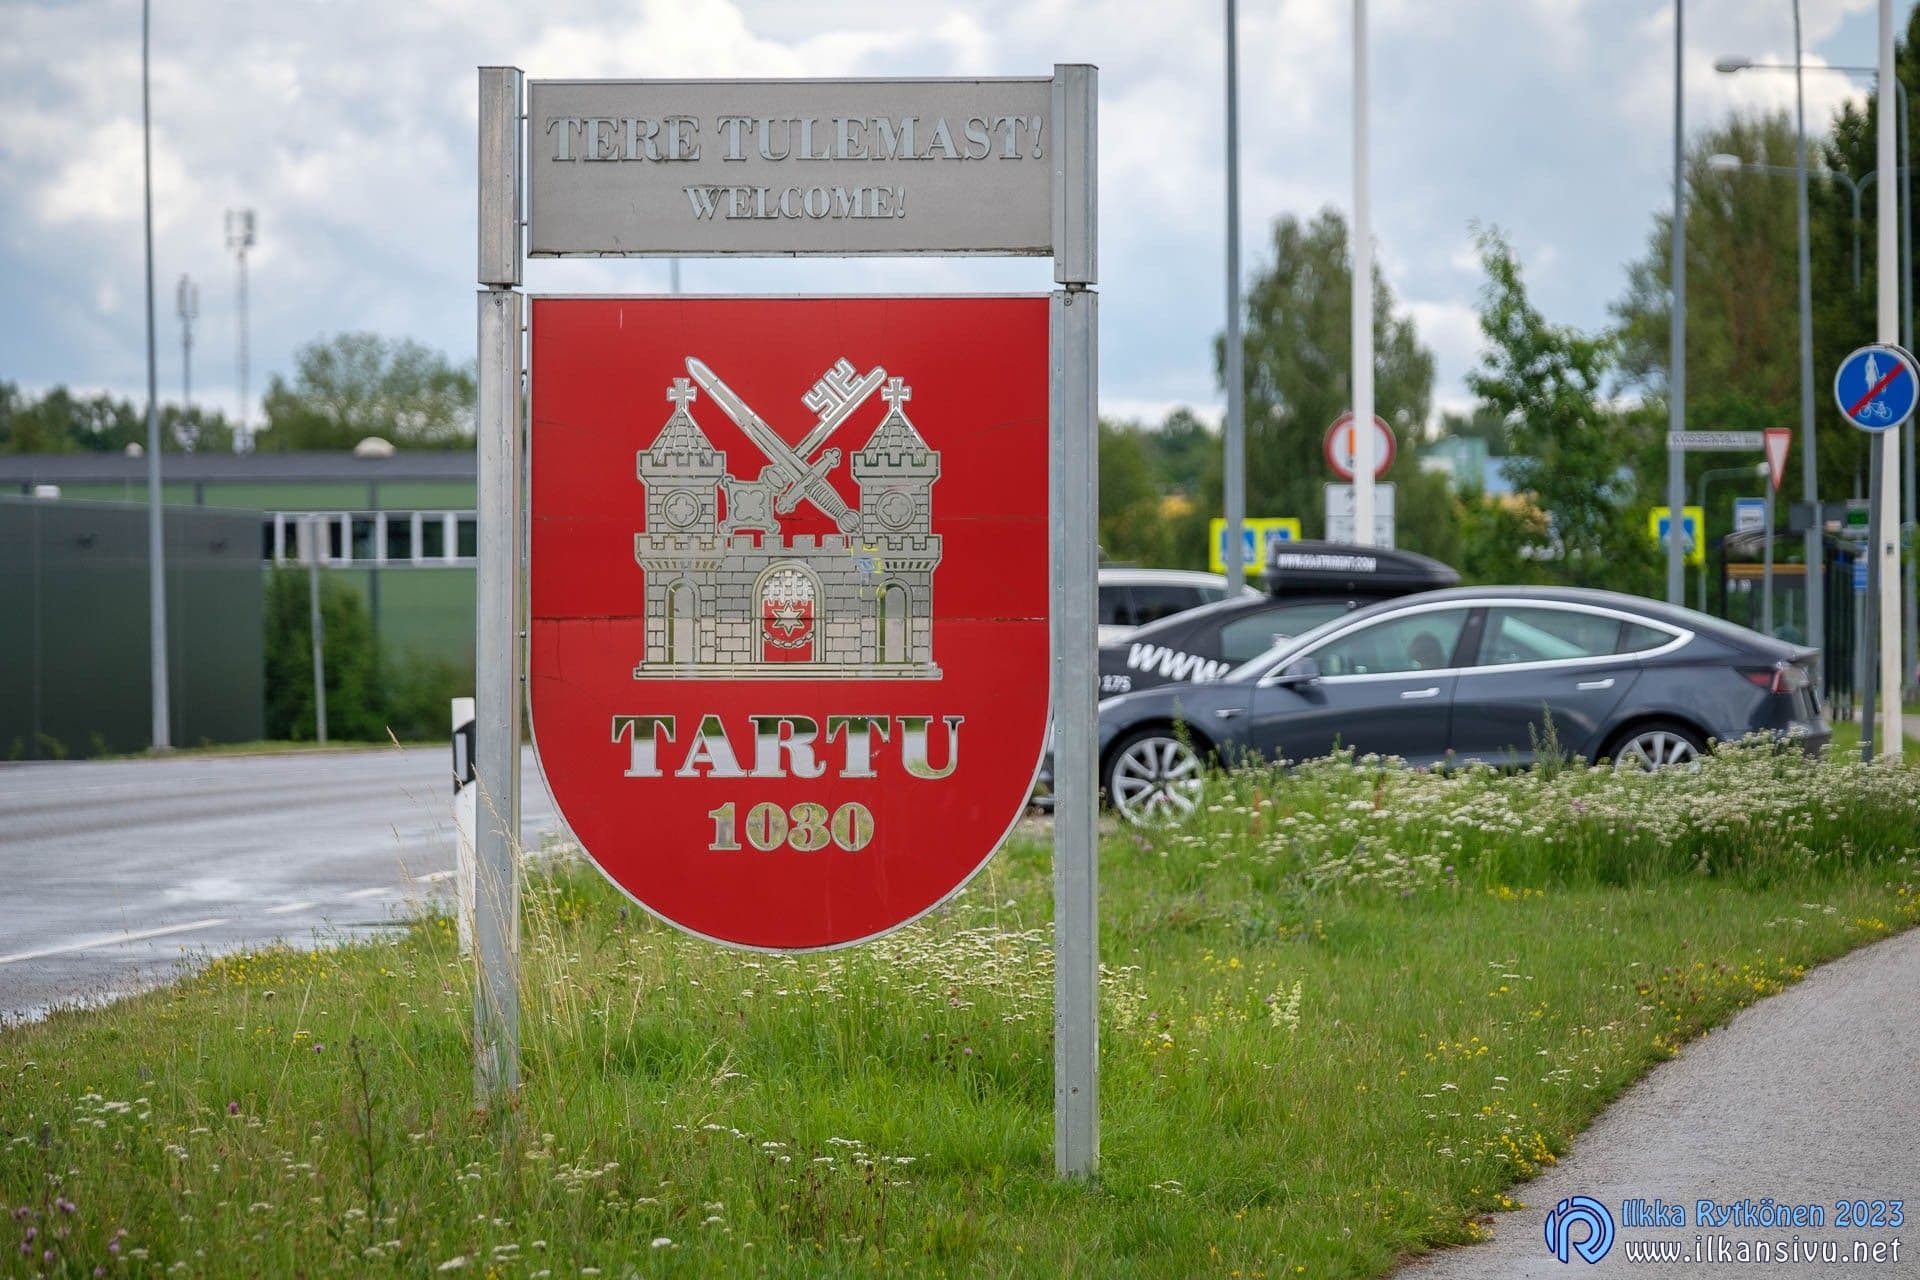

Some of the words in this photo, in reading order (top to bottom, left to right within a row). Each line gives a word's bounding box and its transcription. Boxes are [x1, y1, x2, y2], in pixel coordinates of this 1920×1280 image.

[546, 115, 701, 162] TERE
[717, 115, 1044, 161] TULEMAST!
[684, 184, 907, 220] WELCOME!
[611, 714, 965, 779] TARTU
[708, 801, 875, 852] 1030
